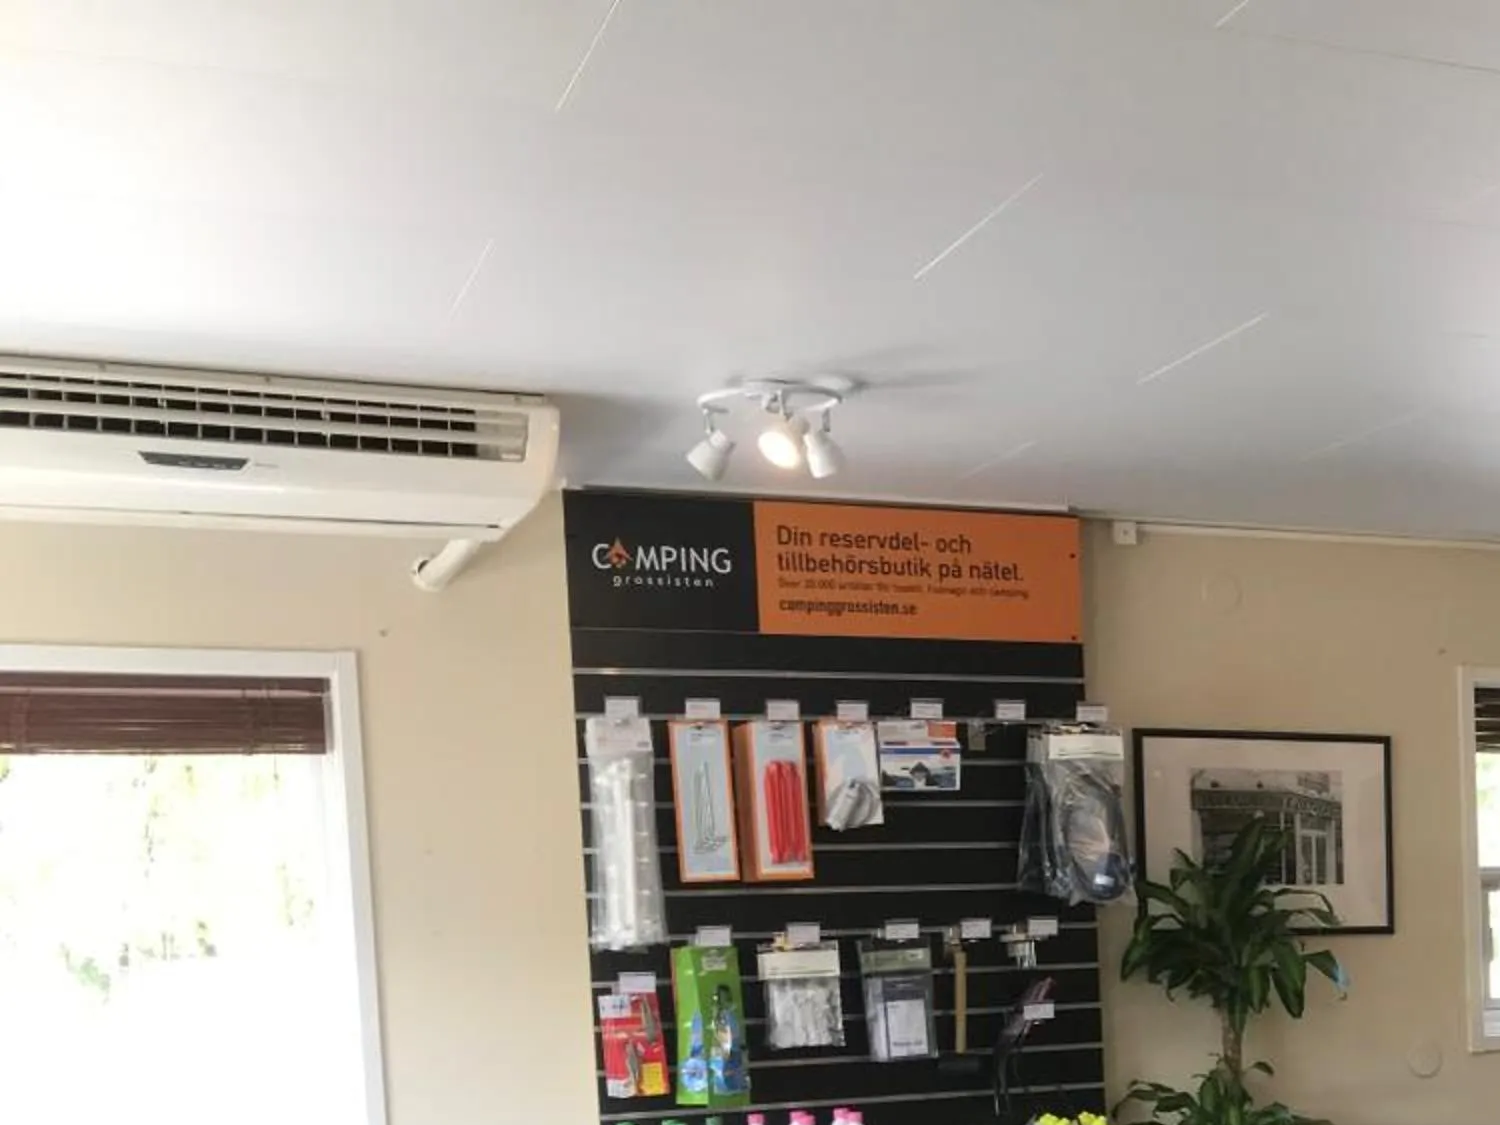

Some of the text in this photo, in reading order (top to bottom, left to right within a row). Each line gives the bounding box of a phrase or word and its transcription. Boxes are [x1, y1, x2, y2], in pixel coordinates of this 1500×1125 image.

[777, 524, 972, 553] Din reservdel- och
[612, 574, 714, 588] grossisten
[777, 552, 932, 578] tillbehörsbutik
[938, 557, 962, 582] på
